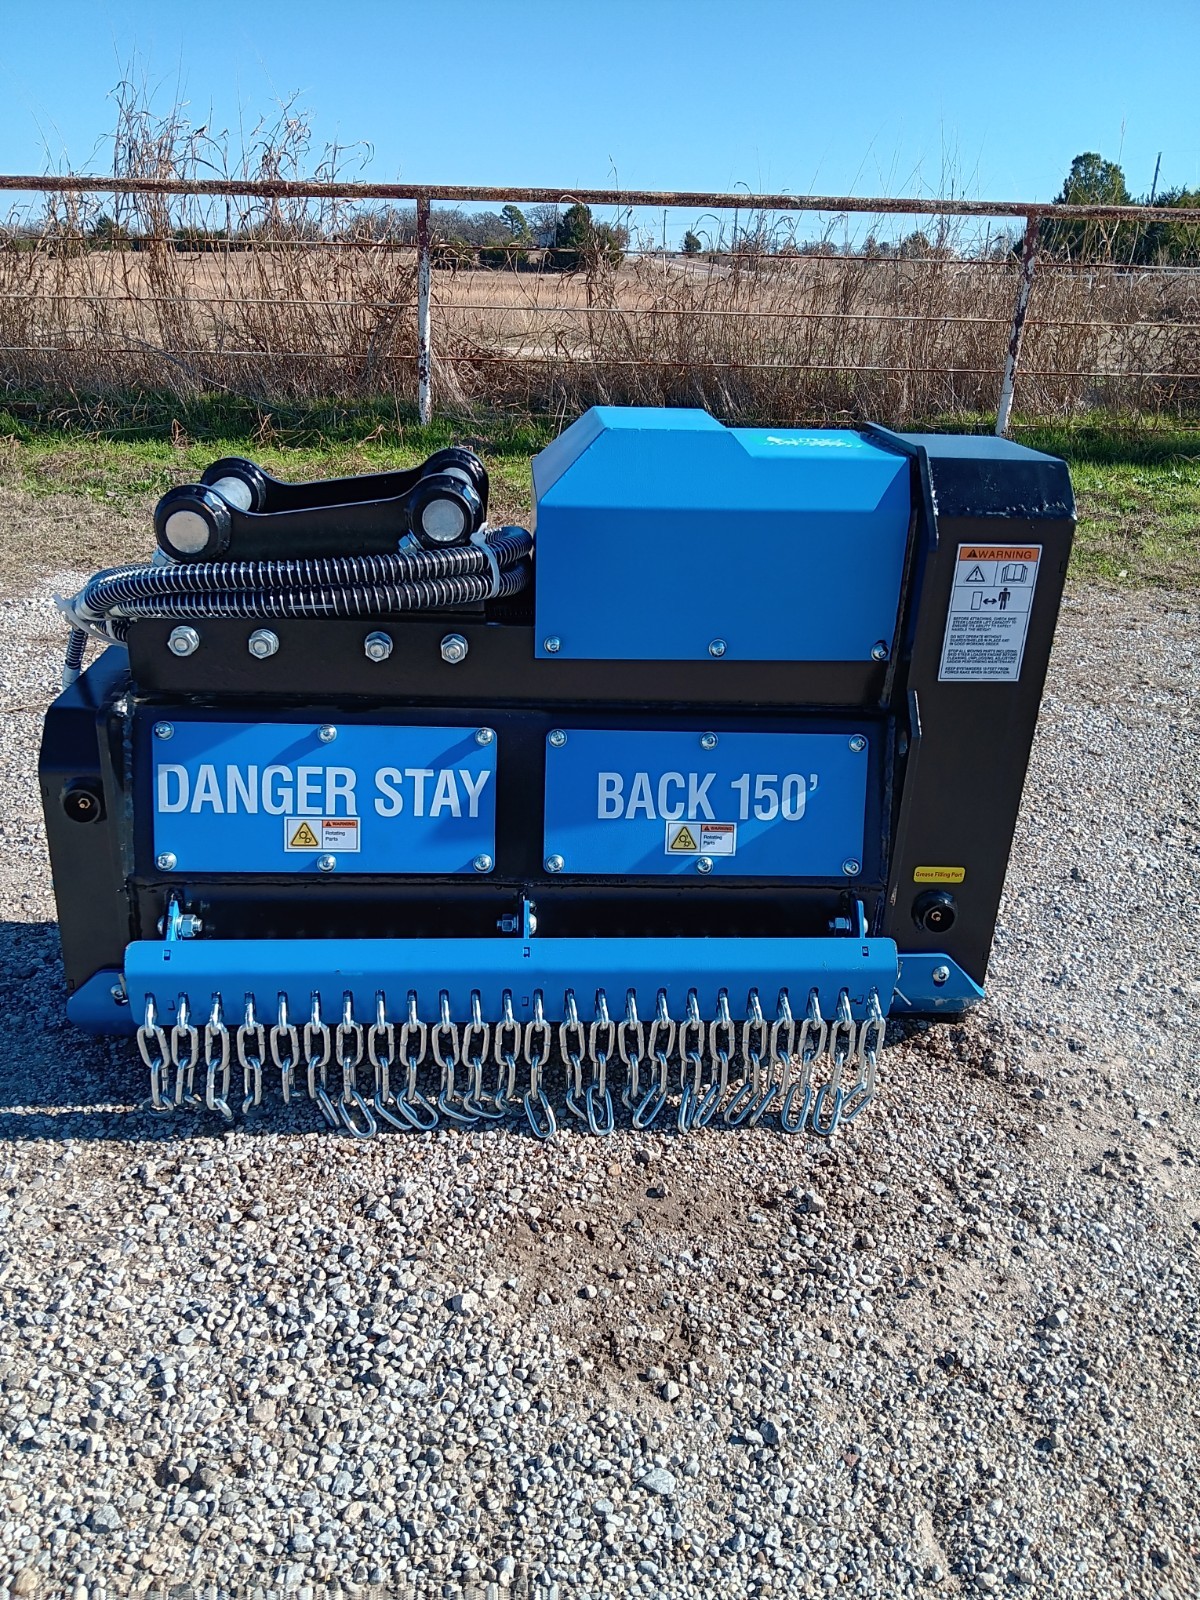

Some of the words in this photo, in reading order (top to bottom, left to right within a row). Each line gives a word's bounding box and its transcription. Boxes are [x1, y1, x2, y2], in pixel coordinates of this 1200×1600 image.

[978, 550, 1032, 560] WARNING
[157, 764, 358, 815] DANGER
[374, 766, 491, 818] STAY
[598, 772, 716, 820] BACK
